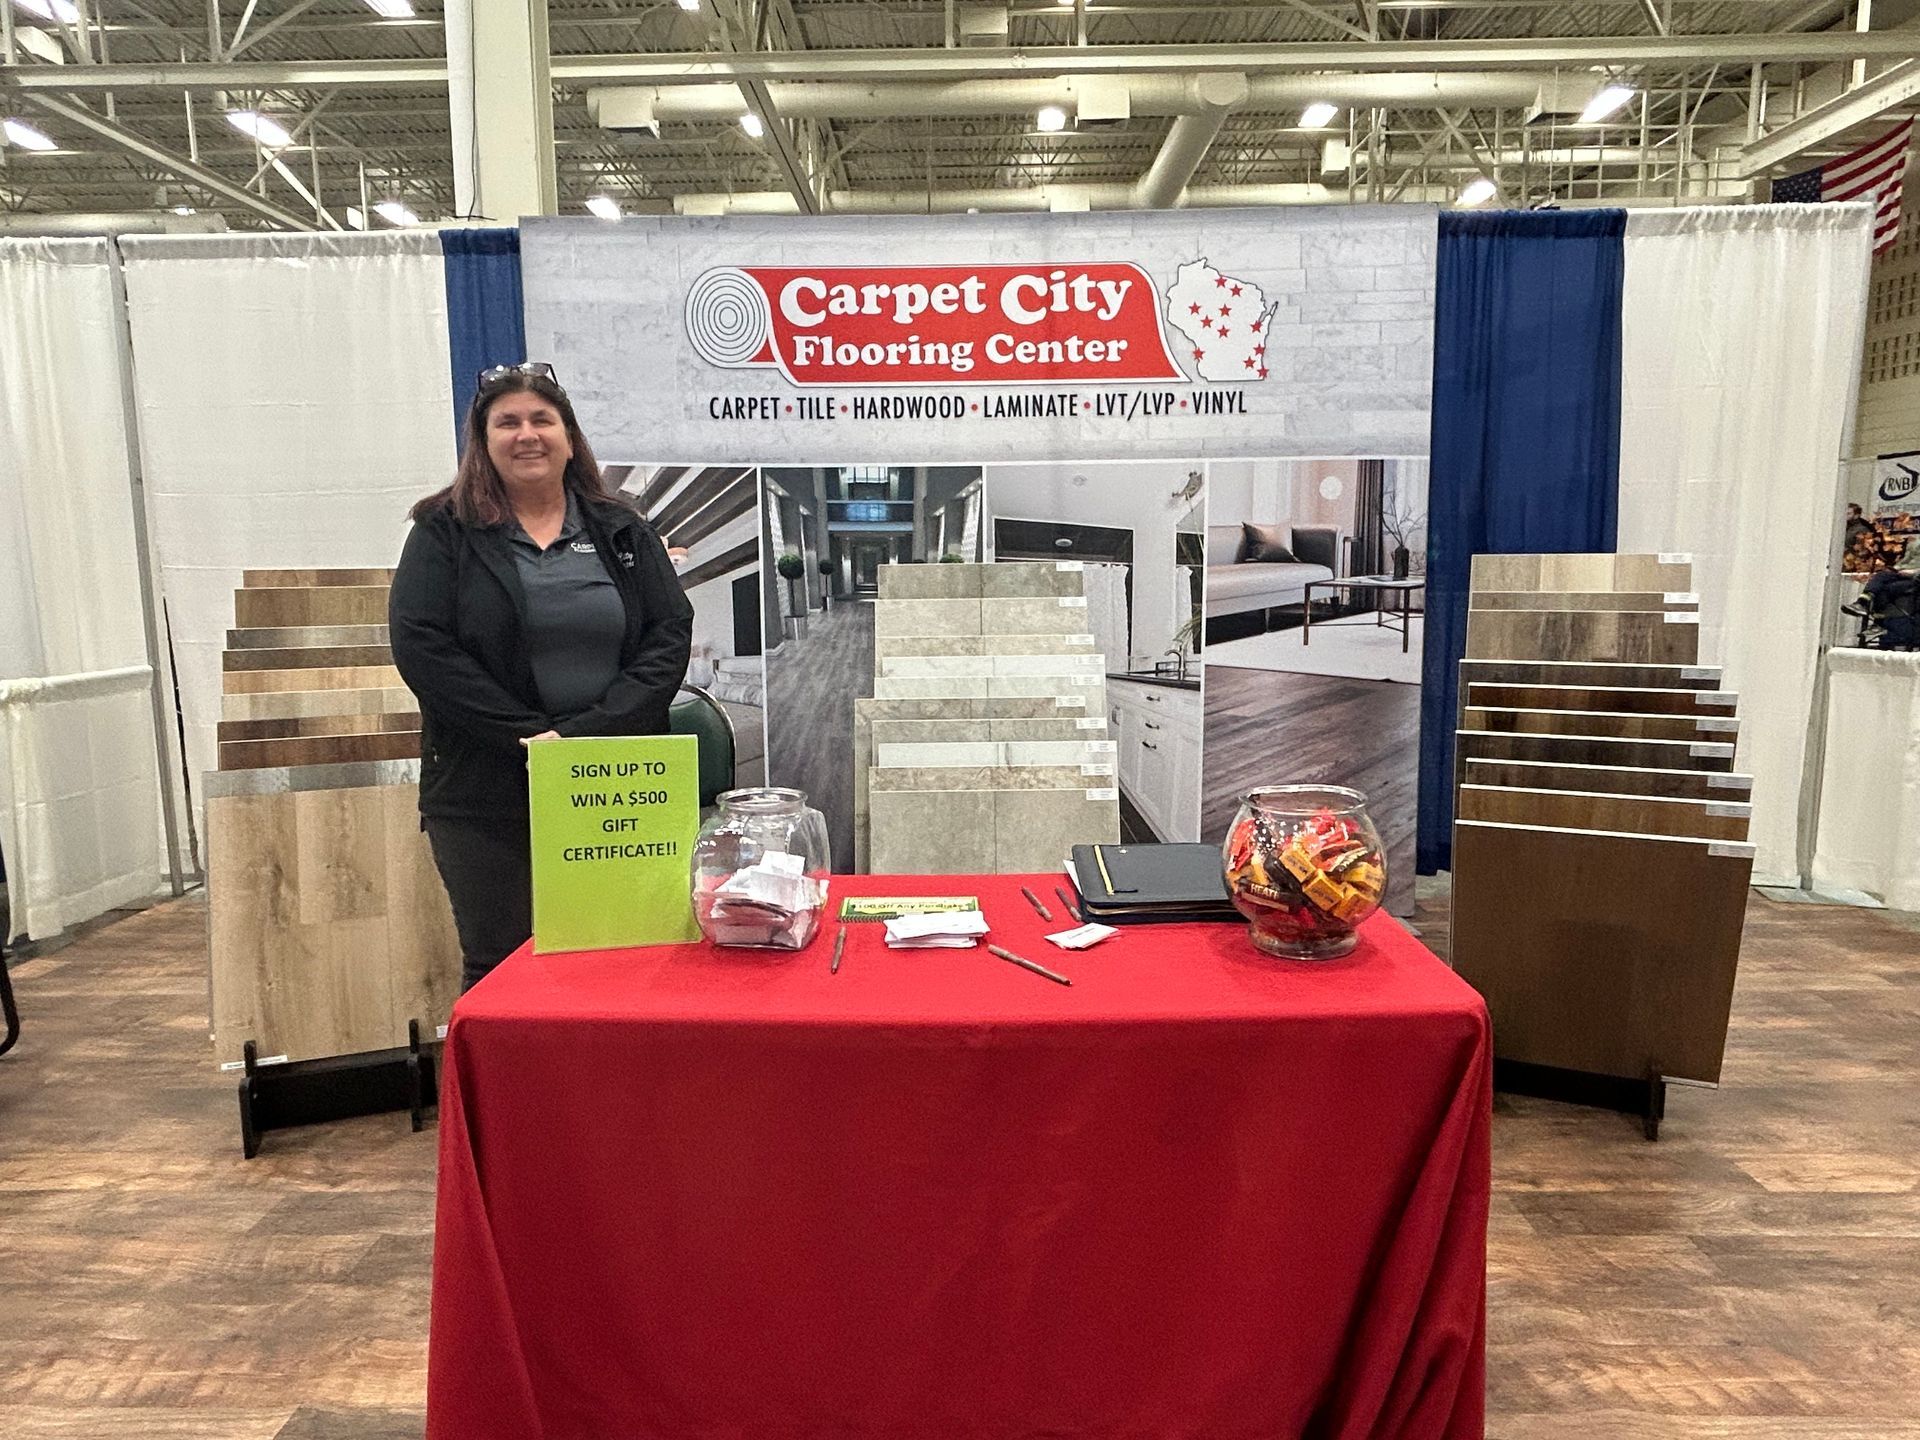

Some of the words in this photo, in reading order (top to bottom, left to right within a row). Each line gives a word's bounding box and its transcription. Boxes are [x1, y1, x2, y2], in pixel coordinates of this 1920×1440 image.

[779, 276, 987, 327] Carpet
[1000, 270, 1133, 325] City
[793, 335, 975, 372] Flooring
[985, 333, 1128, 364] Center
[709, 396, 781, 420] CARPET
[797, 396, 836, 420] TILE
[853, 396, 966, 420] HARDWOOD
[984, 394, 1079, 418] LAMINATE
[1096, 391, 1176, 421] LVT/LVP
[1192, 391, 1248, 415] VINYL
[1888, 477, 1910, 491] RNB
[571, 764, 611, 778] SIGN
[616, 763, 639, 777] UP
[643, 762, 666, 775] TO
[571, 793, 607, 807] WIN
[612, 792, 624, 806] A
[629, 790, 668, 807] $500
[602, 818, 639, 832] GIFT
[563, 841, 677, 861] CERTIFICATE!!
